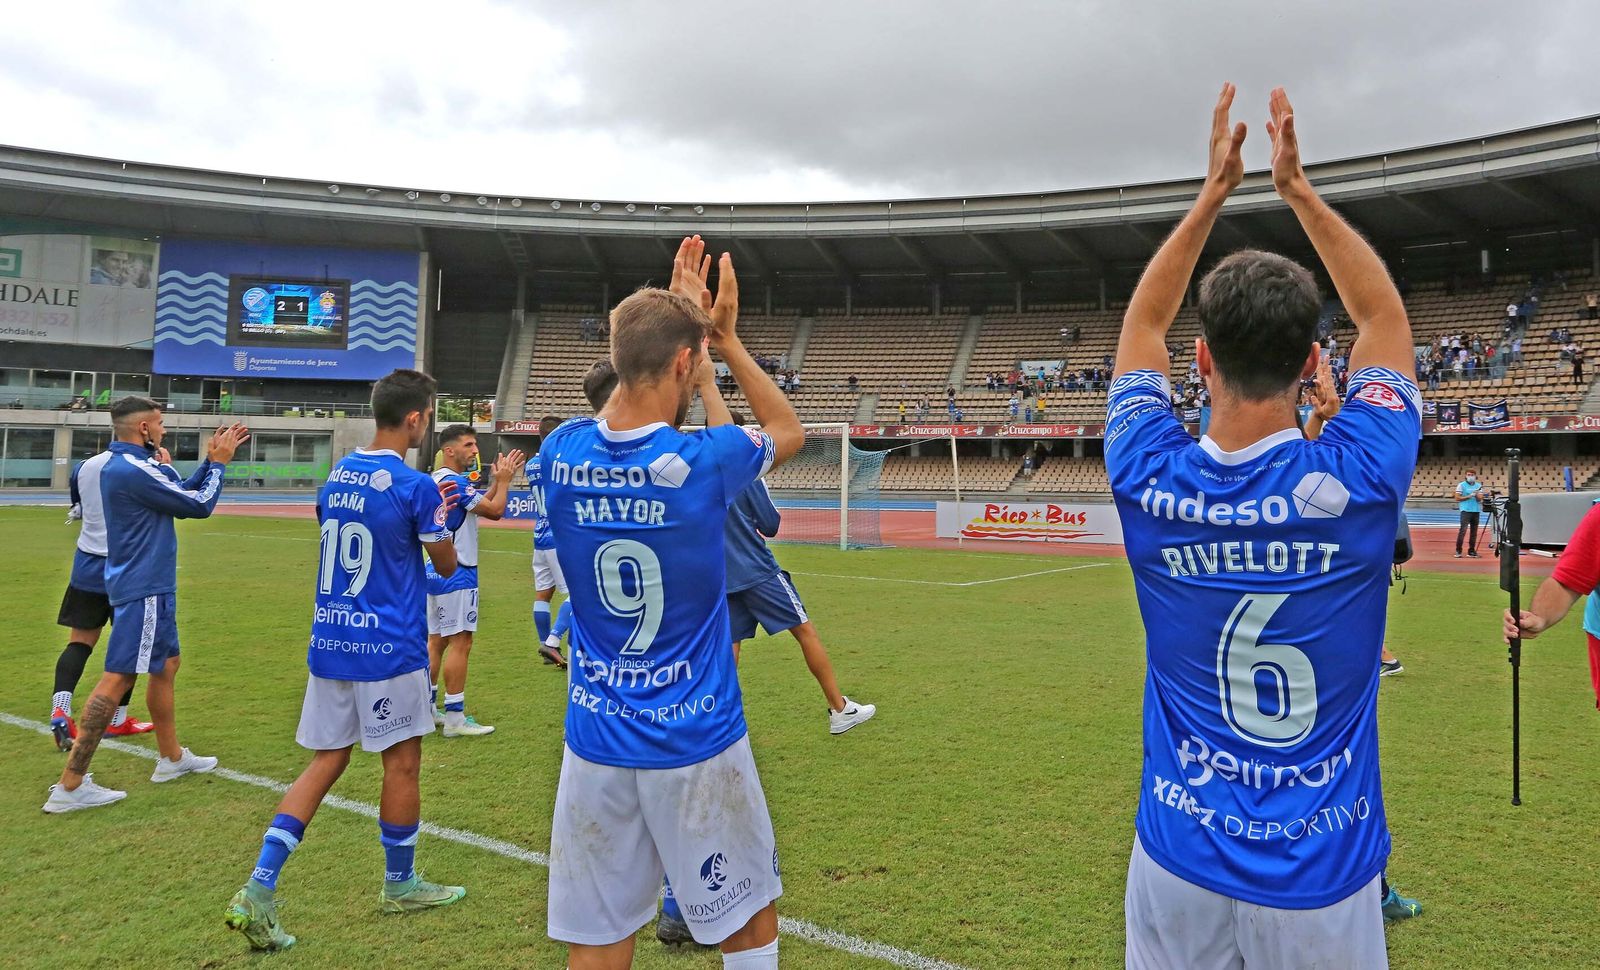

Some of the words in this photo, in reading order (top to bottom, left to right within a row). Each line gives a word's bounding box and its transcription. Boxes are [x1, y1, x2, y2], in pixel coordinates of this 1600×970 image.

[277, 301, 286, 311] 2
[297, 302, 304, 312] 1
[249, 357, 306, 366] Ayuntamiento
[515, 422, 540, 431] Cruzc
[910, 425, 951, 435] Cruzcampo
[1009, 425, 1052, 435] Cruzcampo
[327, 465, 368, 487] ndeso
[551, 453, 645, 488] indeso
[328, 491, 365, 513] OCAÑA
[1140, 478, 1289, 526] indeso
[984, 504, 1027, 525] Rico
[1046, 504, 1087, 526] Bus
[320, 518, 373, 598] 19
[1161, 541, 1340, 577] RIVELOTT
[594, 539, 664, 655] 9
[317, 638, 393, 654] DEPORTIVO
[1216, 593, 1318, 748] 6
[606, 695, 716, 723] DEORTIVO
[1224, 796, 1370, 840] DEPORTIVO
[684, 877, 751, 917] MONTEALTO
